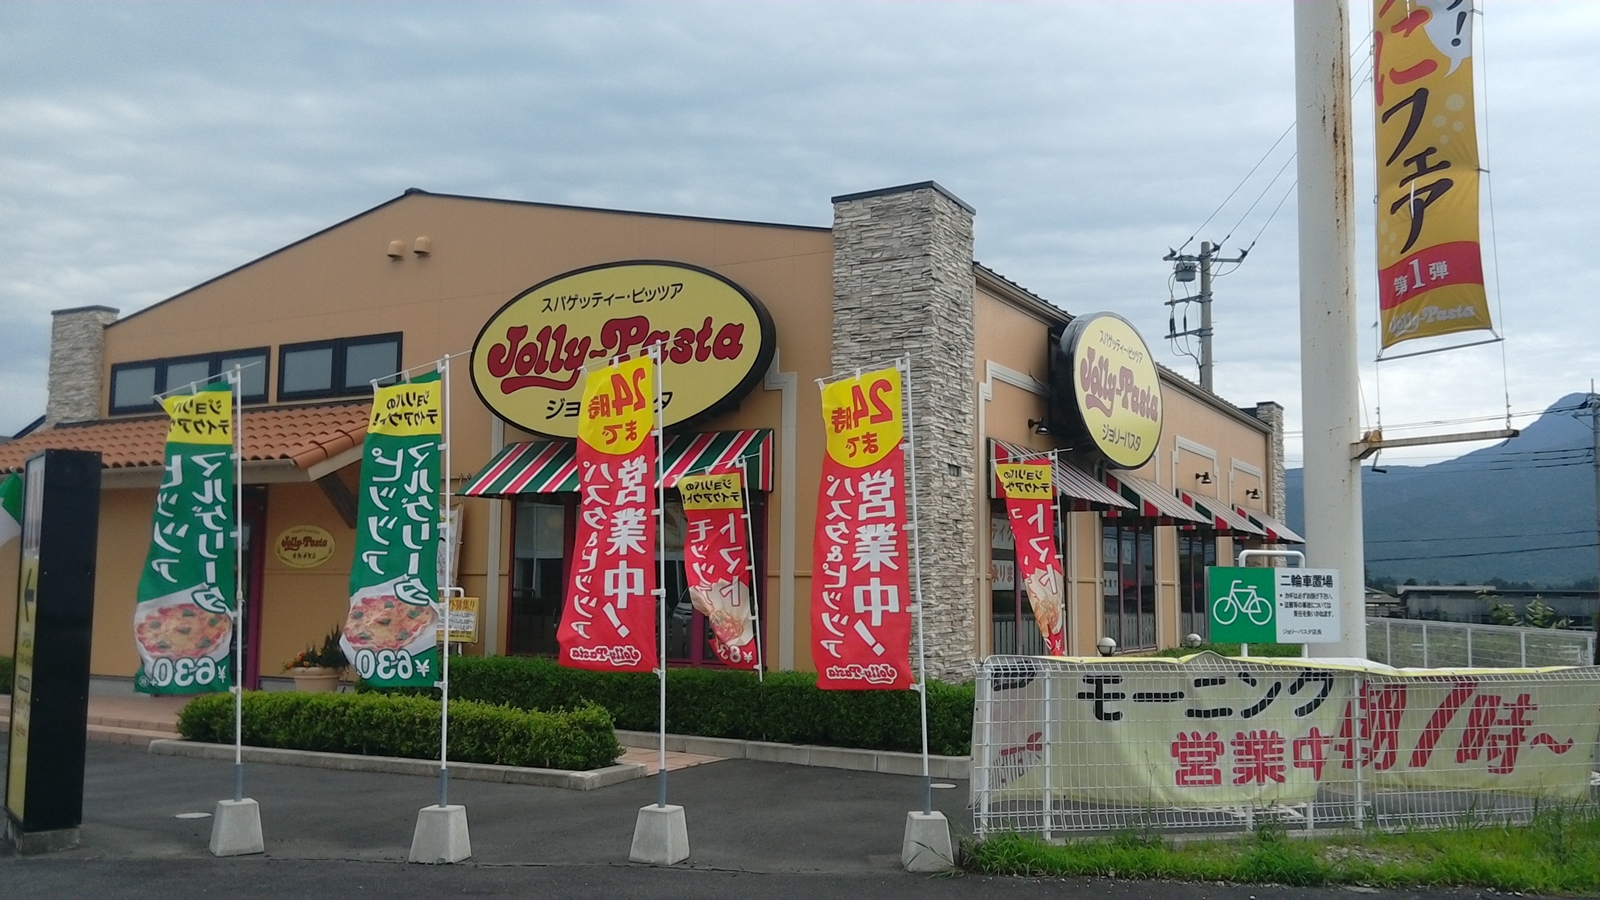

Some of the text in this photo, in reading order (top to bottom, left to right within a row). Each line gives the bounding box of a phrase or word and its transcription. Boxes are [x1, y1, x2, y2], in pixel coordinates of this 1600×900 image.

[1393, 259, 1449, 297] 第1弾
[487, 315, 744, 394] Jolly-Pasta
[1080, 346, 1158, 422] Jolly-Pasta
[1102, 424, 1141, 452] ジョリーパスタ
[1280, 574, 1333, 588] 二輪車置場
